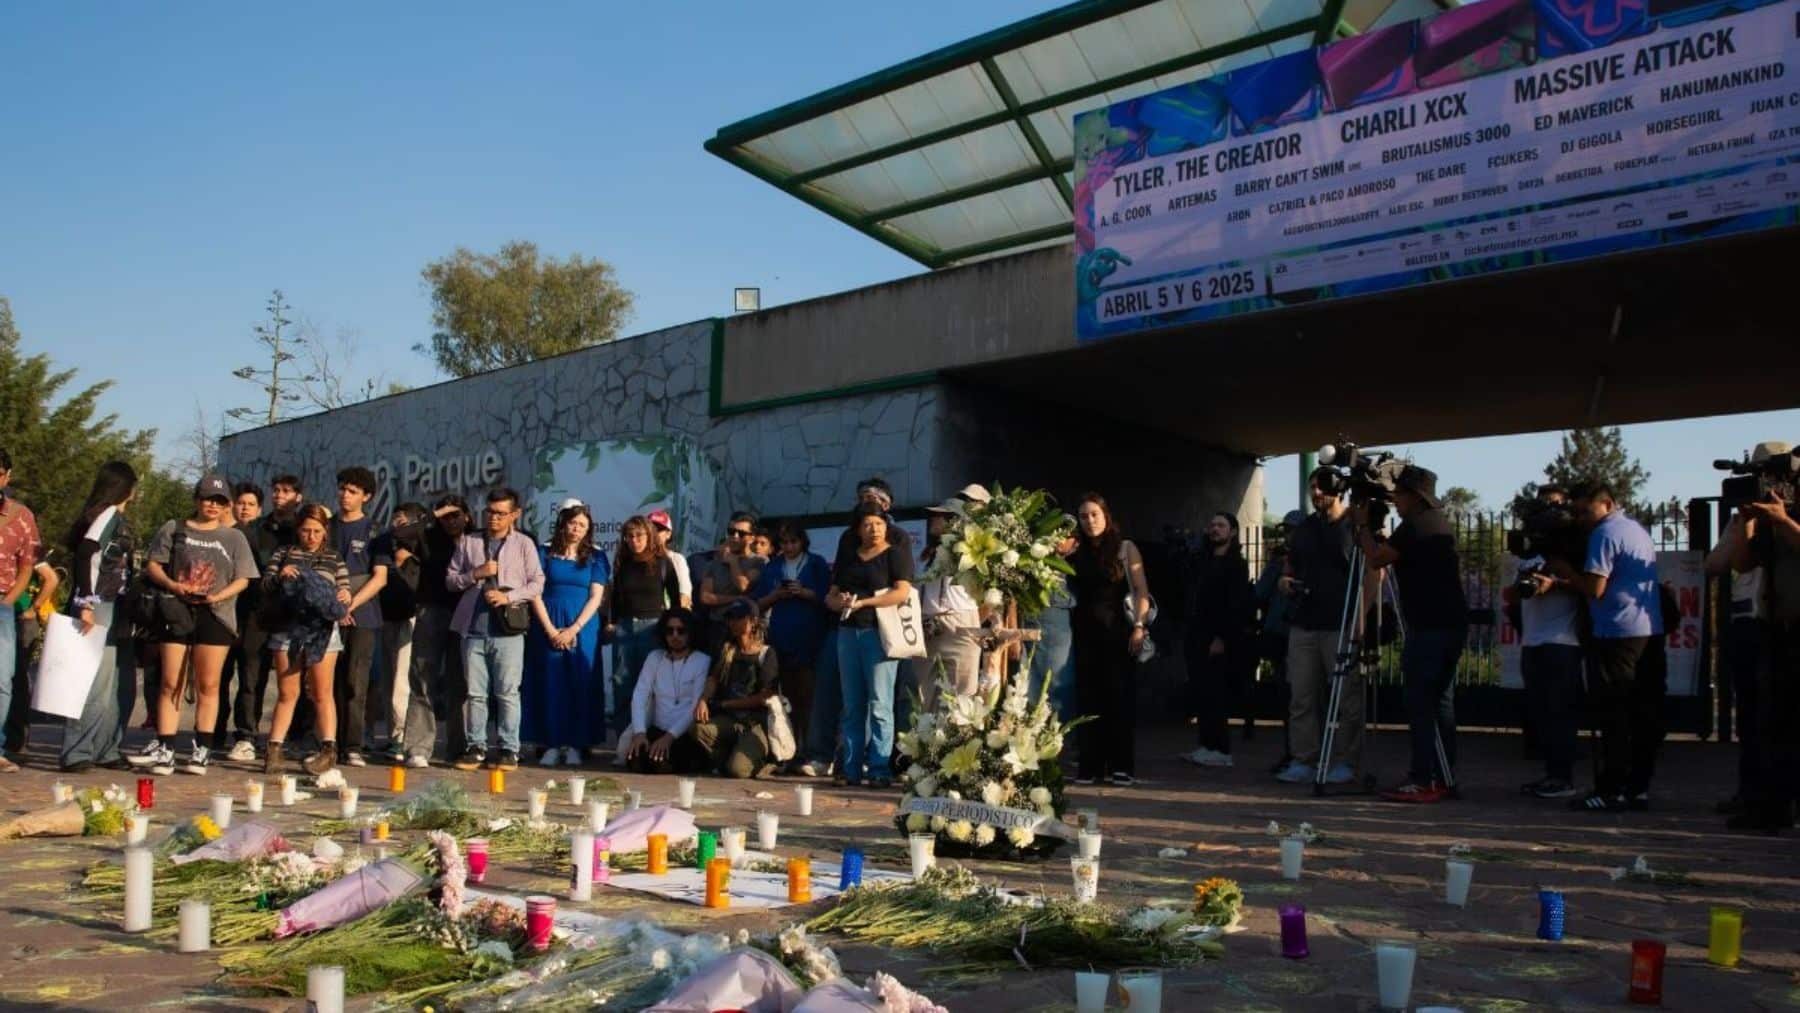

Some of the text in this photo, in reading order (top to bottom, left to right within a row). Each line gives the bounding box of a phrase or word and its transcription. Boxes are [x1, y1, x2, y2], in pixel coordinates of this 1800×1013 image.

[1514, 27, 1736, 104] MASSIVE ATTACK
[1660, 62, 1785, 103] HANUMANKIND
[1341, 92, 1468, 144] CHARLI XCX
[1535, 95, 1635, 132] ED MAVERICK
[1749, 92, 1800, 115] JUAN C
[1647, 108, 1723, 137] HORSEGIIRL
[1176, 155, 1209, 183] THE
[1215, 133, 1302, 173] CREATOR
[1382, 124, 1511, 164] BRUTALISMUS 3000
[1487, 148, 1539, 168] FCUKERS
[1561, 130, 1622, 154] DJ GIGOLA
[1235, 178, 1271, 197] BARRY
[1275, 168, 1309, 188] CAN'T
[1312, 160, 1345, 180] SWIM
[1320, 189, 1344, 204] PACO
[1347, 177, 1396, 198] AMOROSO
[1416, 162, 1467, 184] THE DARE
[1100, 215, 1110, 228] A.
[1125, 204, 1152, 221] COOK
[1168, 189, 1217, 212] ARTEMAS
[1104, 271, 1255, 318] ABRIL 5 Y 6 2025
[404, 450, 504, 494] Parque
